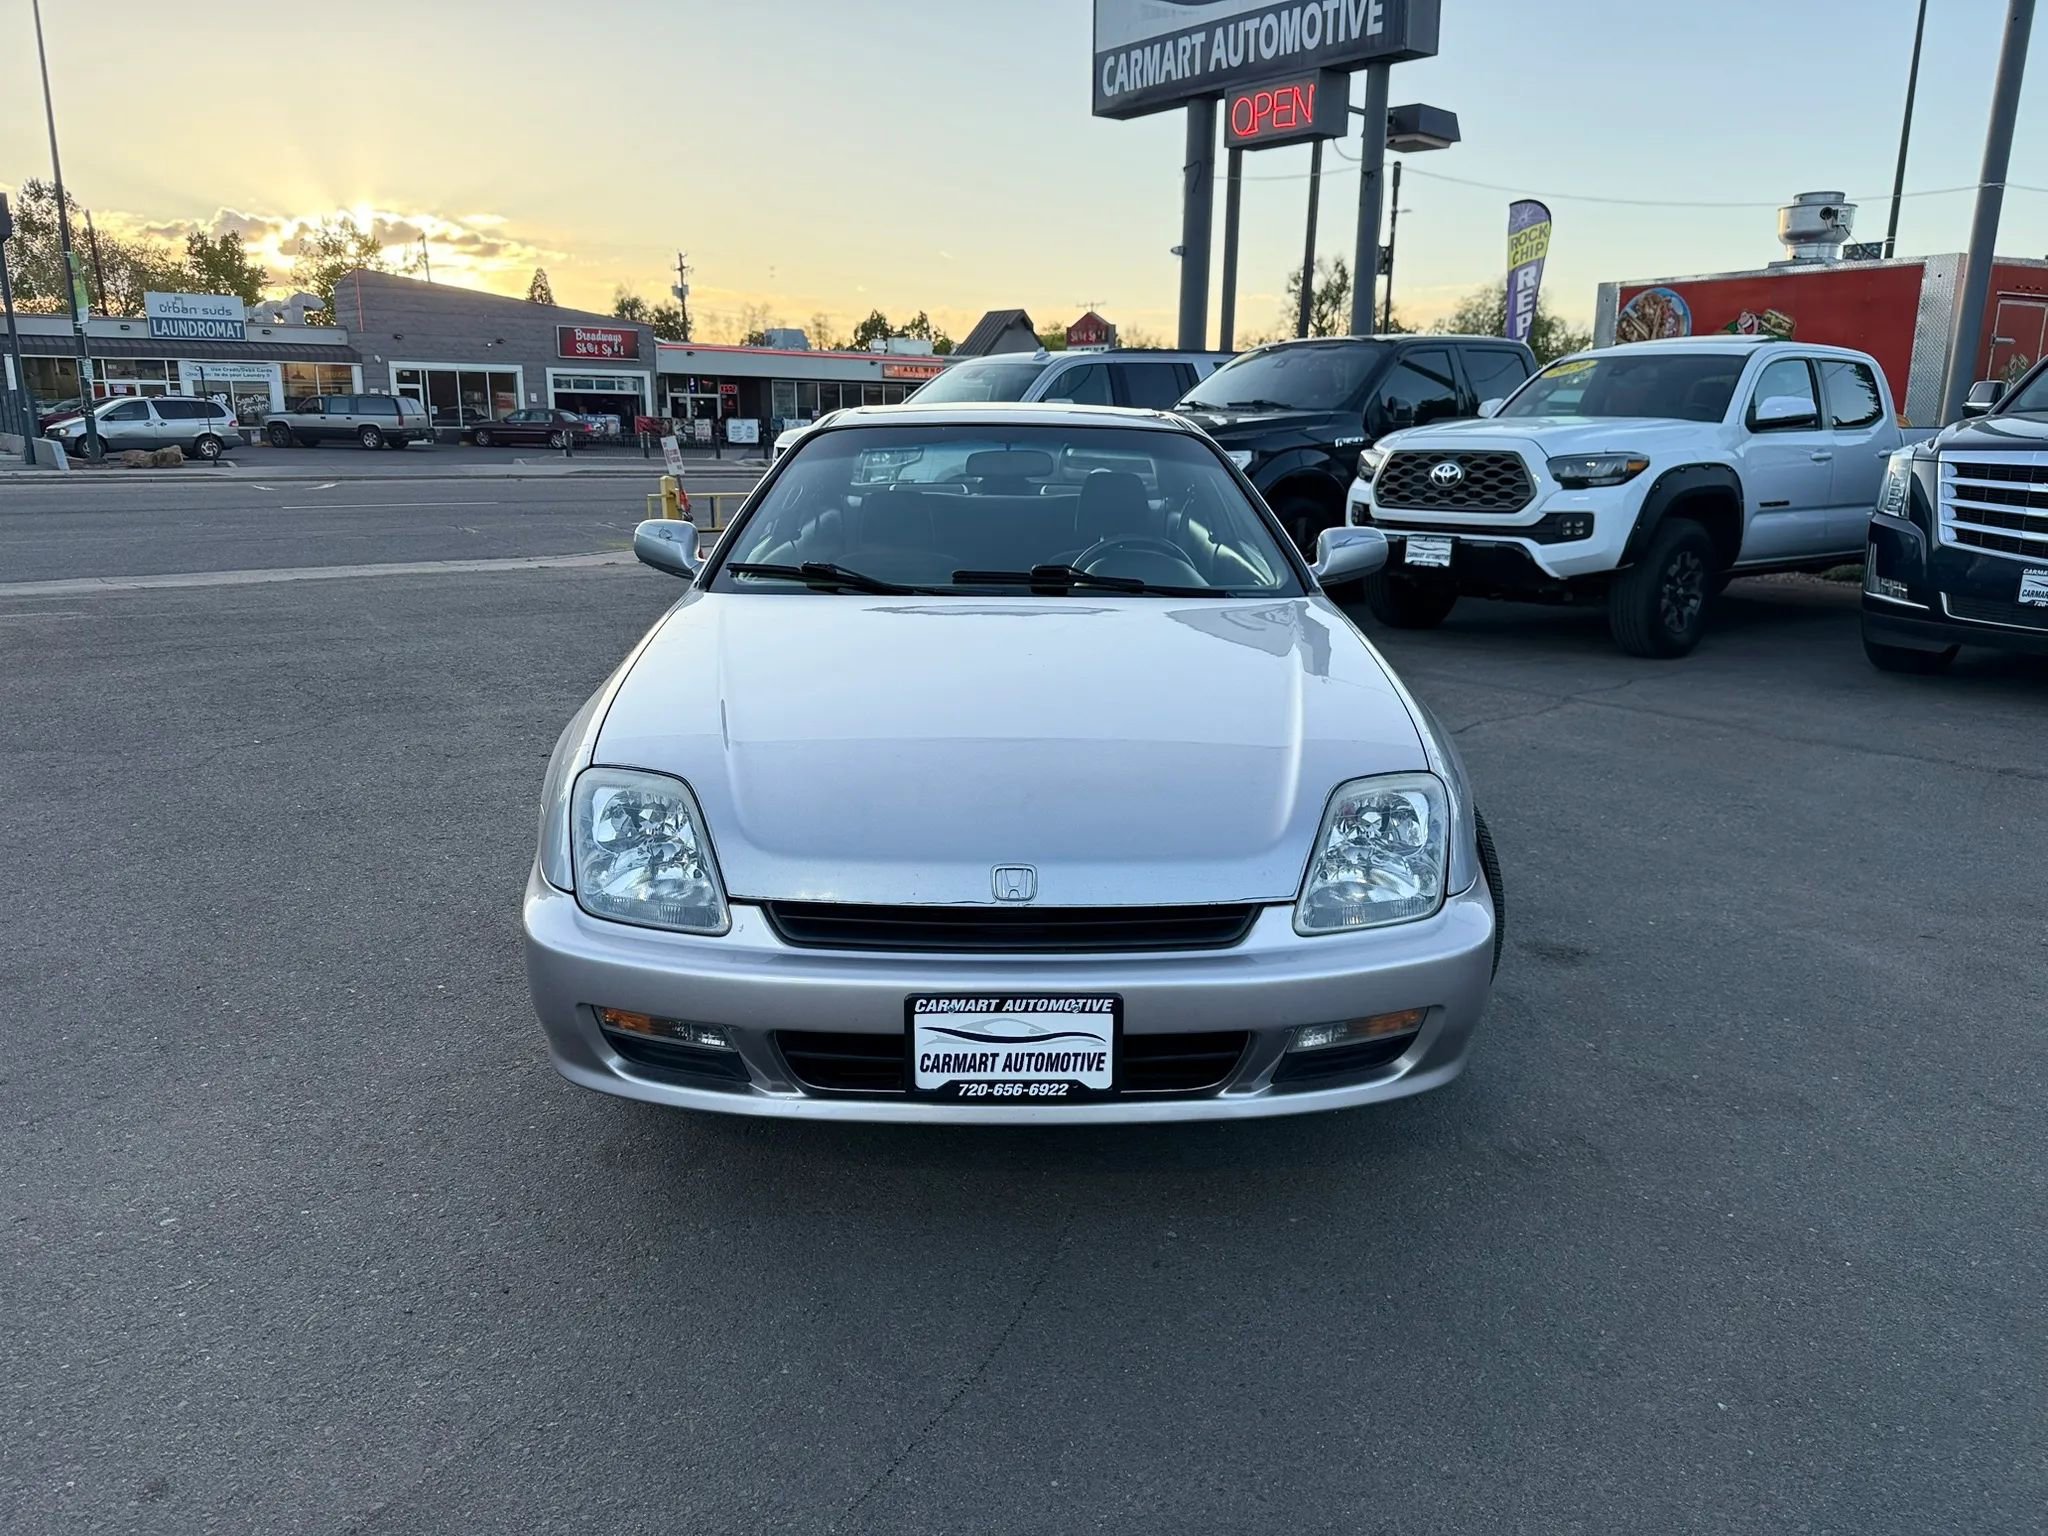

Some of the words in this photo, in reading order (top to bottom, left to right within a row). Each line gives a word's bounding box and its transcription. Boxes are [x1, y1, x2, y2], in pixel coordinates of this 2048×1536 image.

[1102, 32, 1206, 97] CARMART
[1208, 0, 1384, 72] AUTOMOTIVE
[1231, 83, 1315, 136] OPEN
[1510, 222, 1548, 252] ROCK
[1512, 241, 1545, 266] CHIP
[201, 306, 233, 316] suds
[1516, 265, 1538, 342] REP
[152, 319, 242, 338] LAUNDROMAT
[914, 999, 999, 1013] CARMART
[1001, 998, 1114, 1013] AUTOMOTIVE
[919, 1052, 999, 1073] CARMART
[1002, 1052, 1107, 1073] AUTOMOTIVE
[958, 1083, 1069, 1097] 720-656-6922
